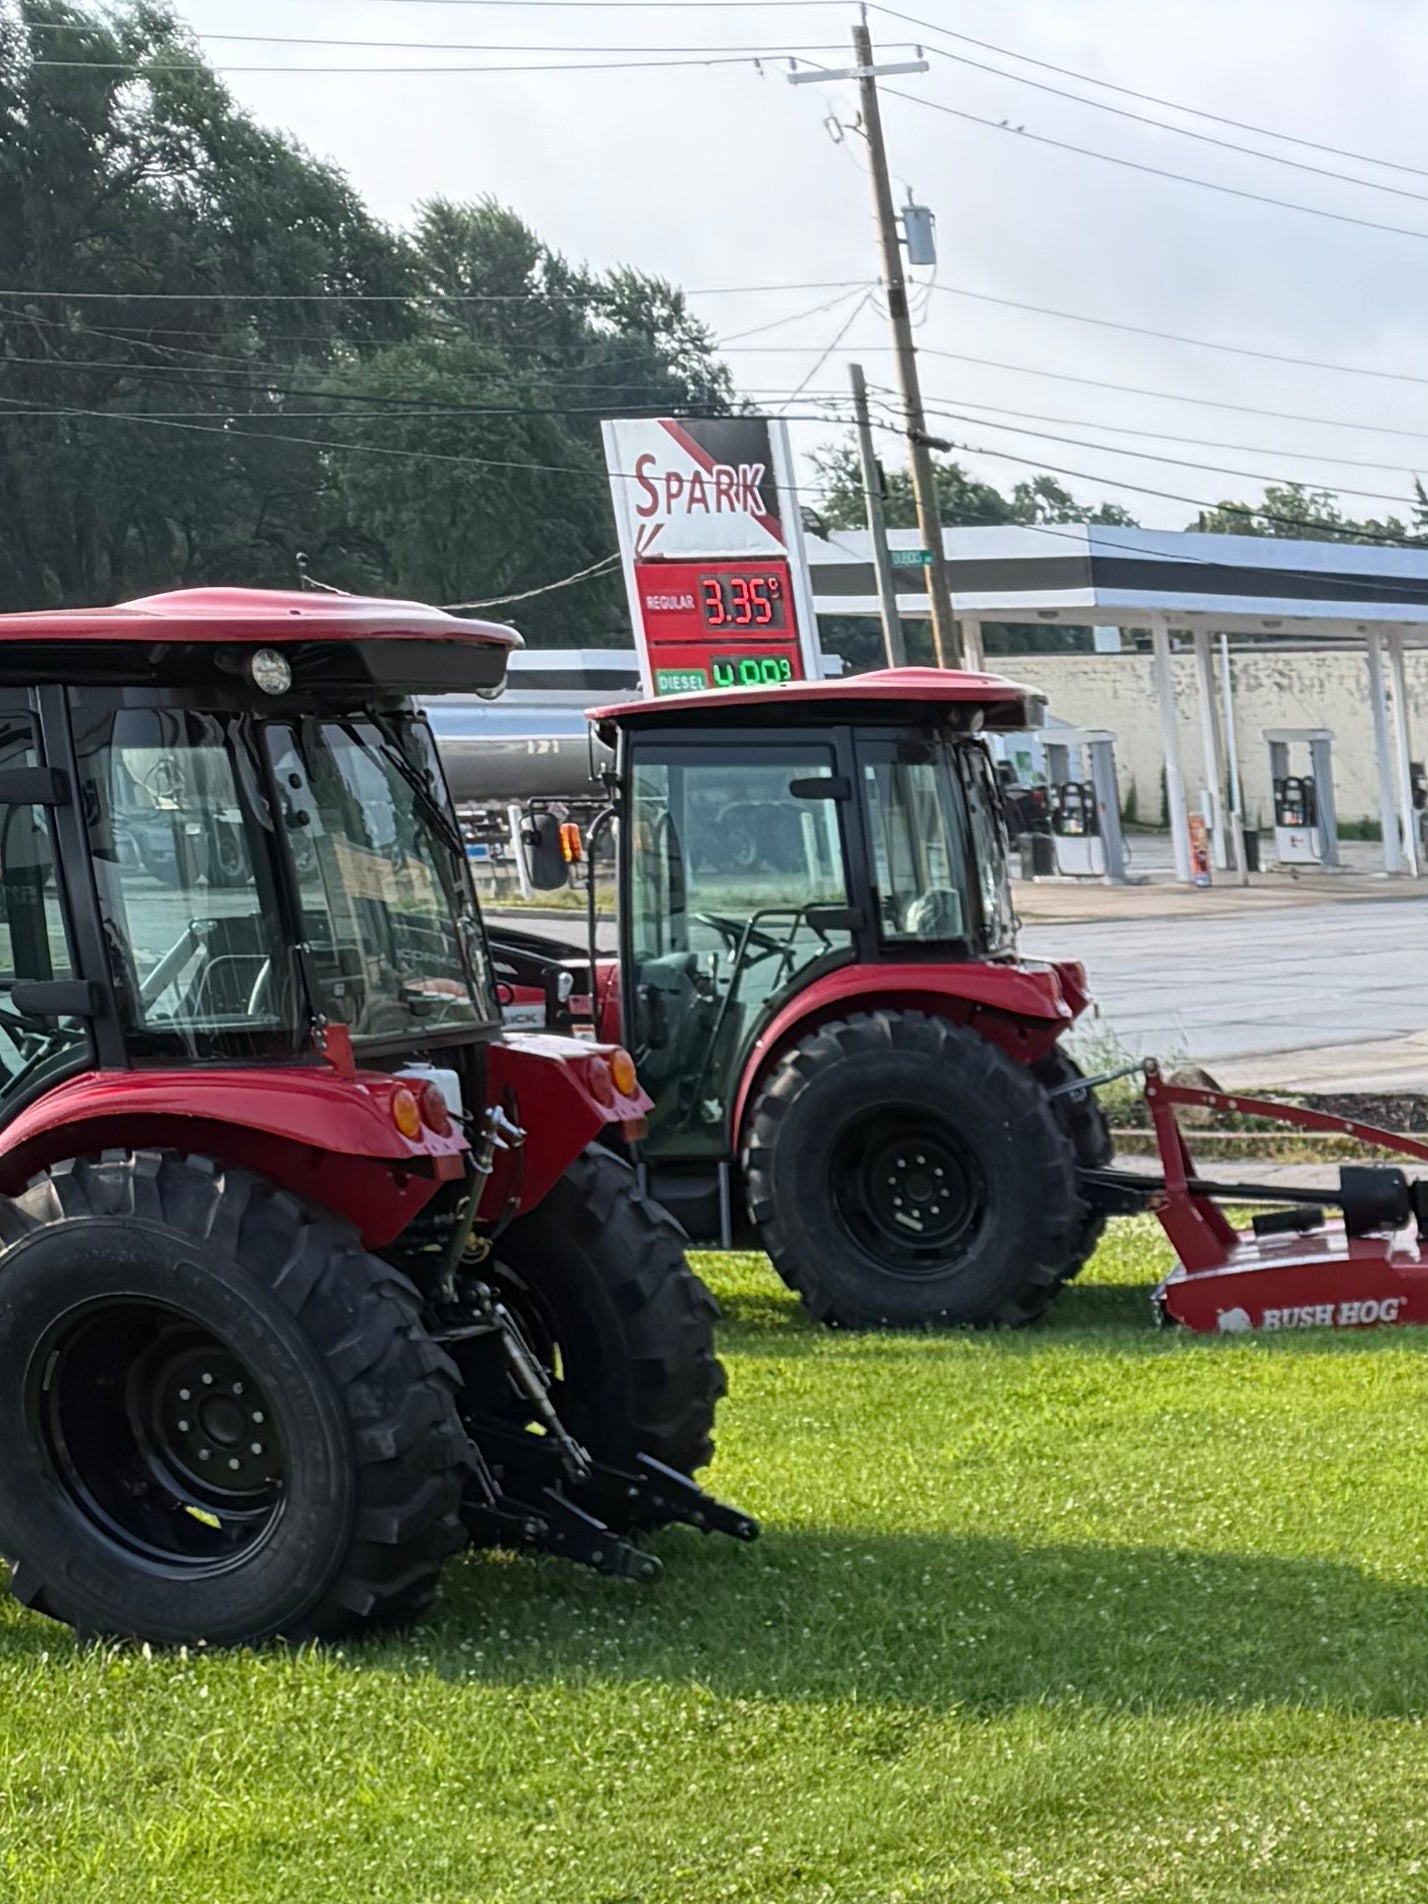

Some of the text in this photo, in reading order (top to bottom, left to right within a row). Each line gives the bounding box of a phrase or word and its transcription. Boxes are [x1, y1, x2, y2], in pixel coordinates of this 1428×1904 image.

[635, 453, 767, 518] SPARK
[646, 593, 696, 612] REGULAR
[659, 676, 707, 691] DIESEL
[1263, 1304, 1335, 1332] BUSH
